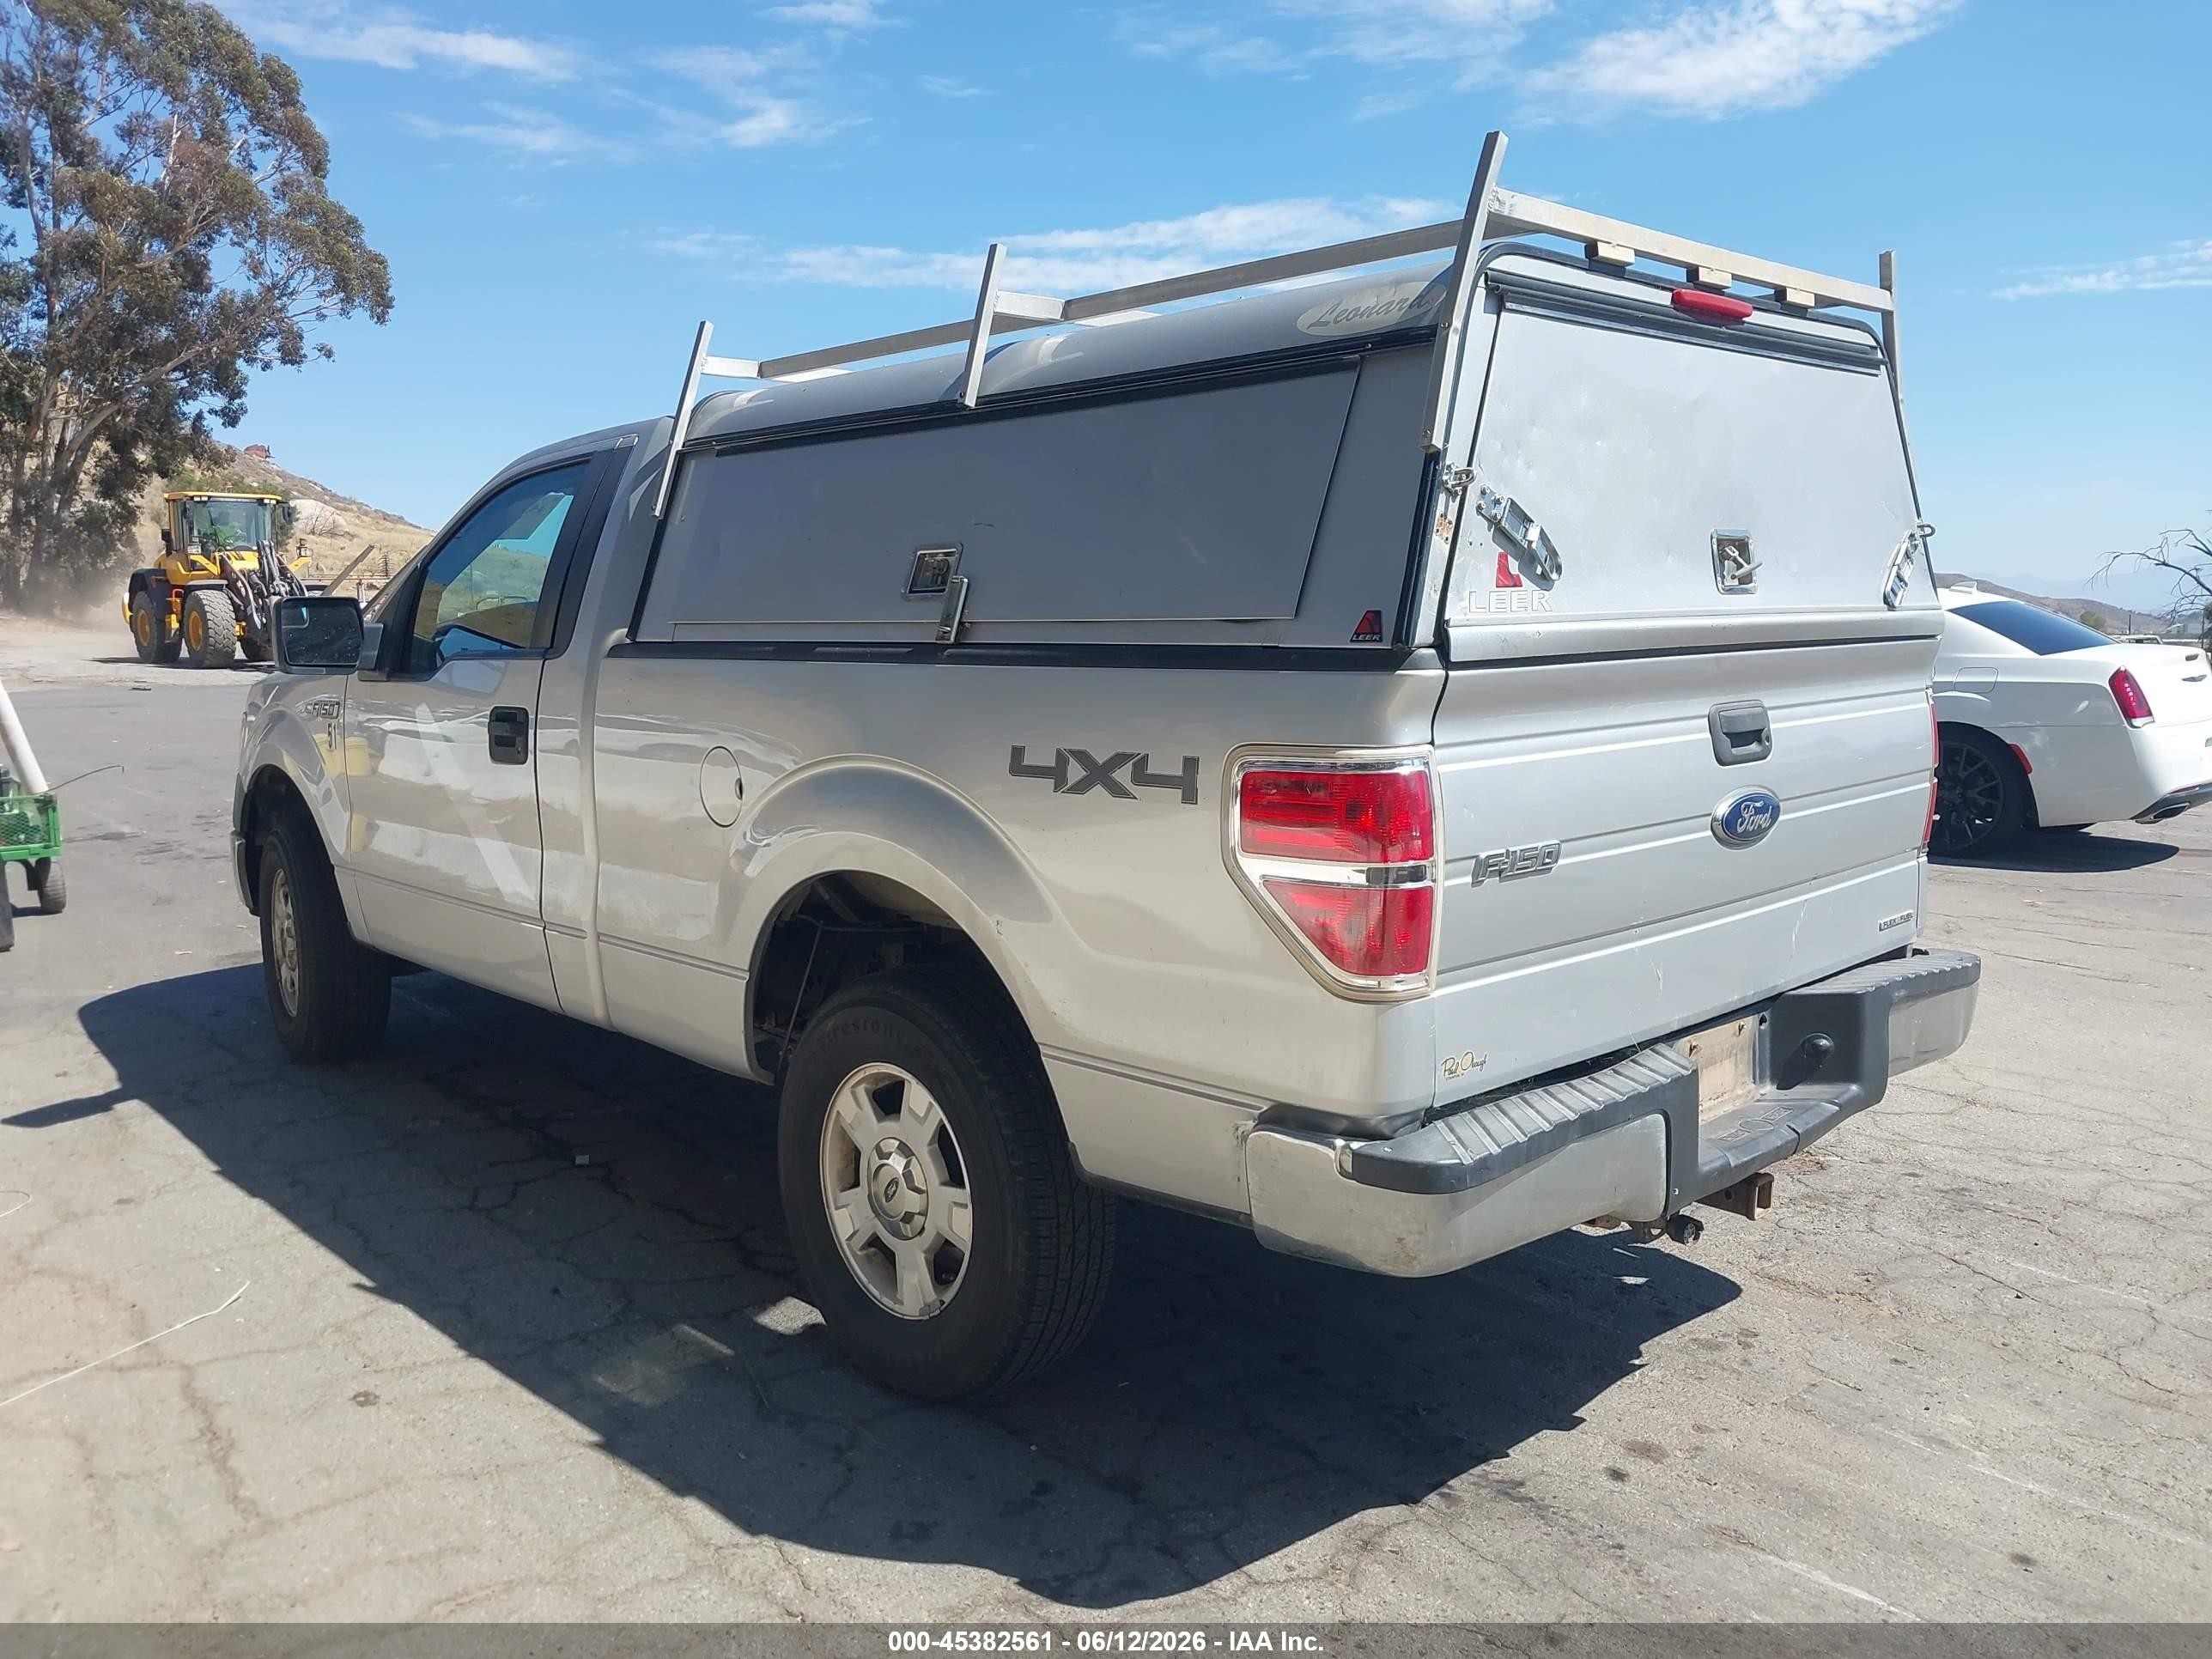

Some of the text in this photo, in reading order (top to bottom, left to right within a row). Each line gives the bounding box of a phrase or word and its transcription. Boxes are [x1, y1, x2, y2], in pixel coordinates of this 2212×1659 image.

[1307, 286, 1434, 330] Leonard
[1469, 589, 1553, 612] LEER
[1736, 800, 1772, 833] Ford
[1883, 912, 1913, 927] FLEX FUEL
